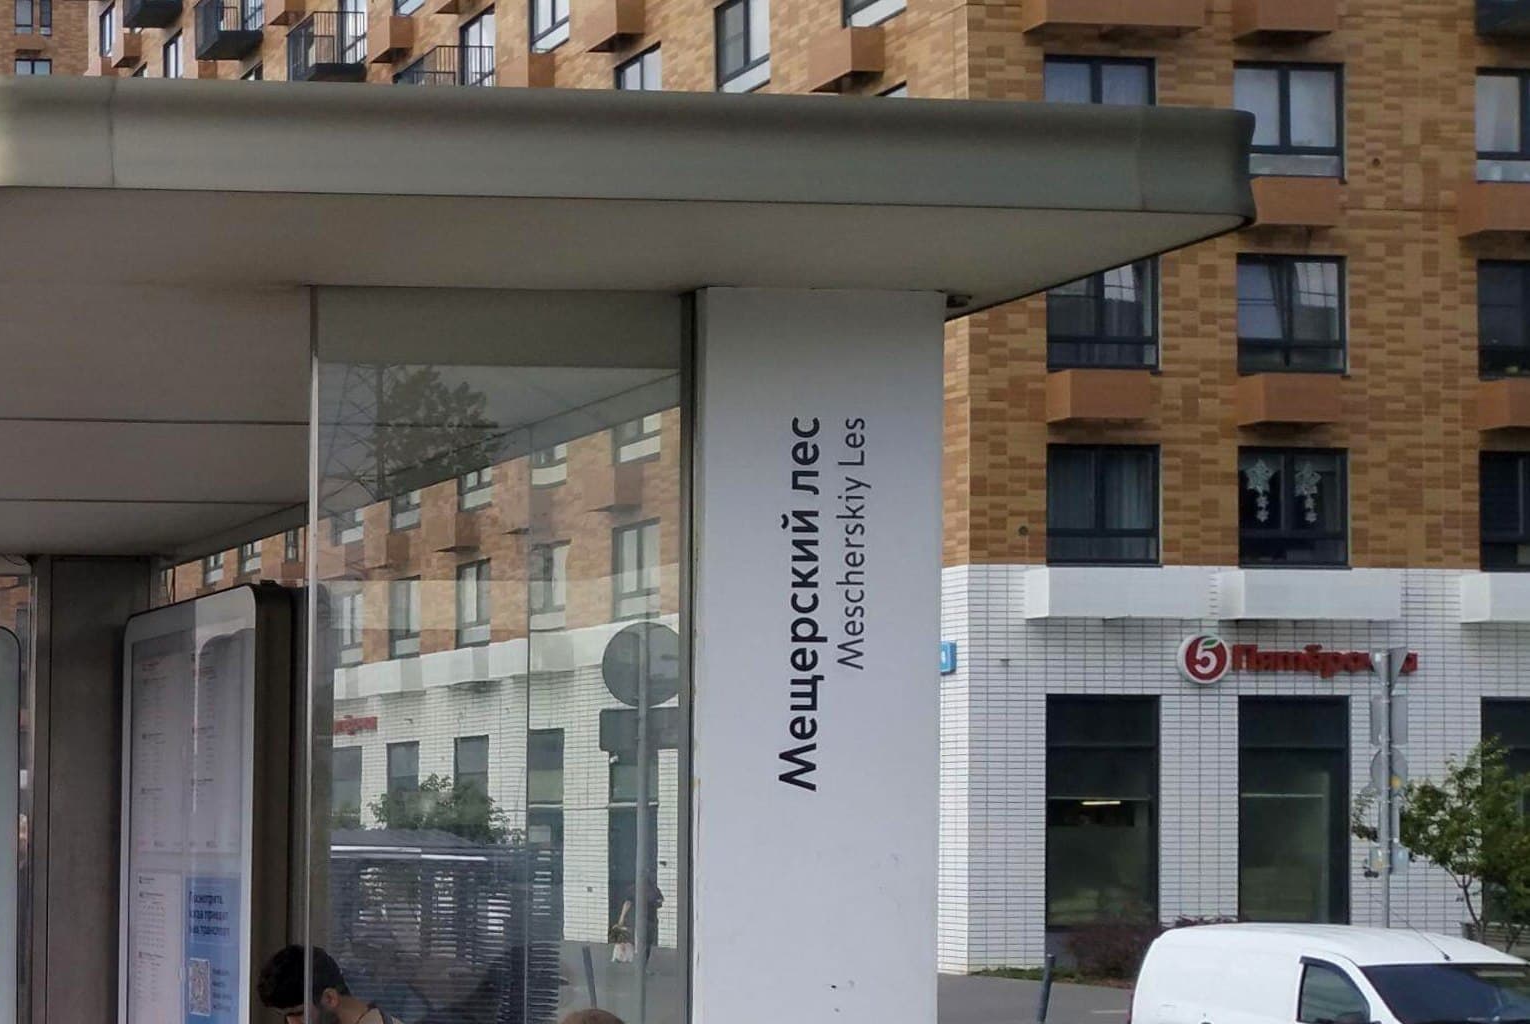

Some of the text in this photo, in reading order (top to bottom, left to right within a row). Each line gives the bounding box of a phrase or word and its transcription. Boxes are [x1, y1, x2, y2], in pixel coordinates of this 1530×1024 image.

[778, 416, 828, 792] Мещерский лес
[836, 417, 871, 670] Mescherskiy Les
[1231, 644, 1418, 680] Пятёроа
